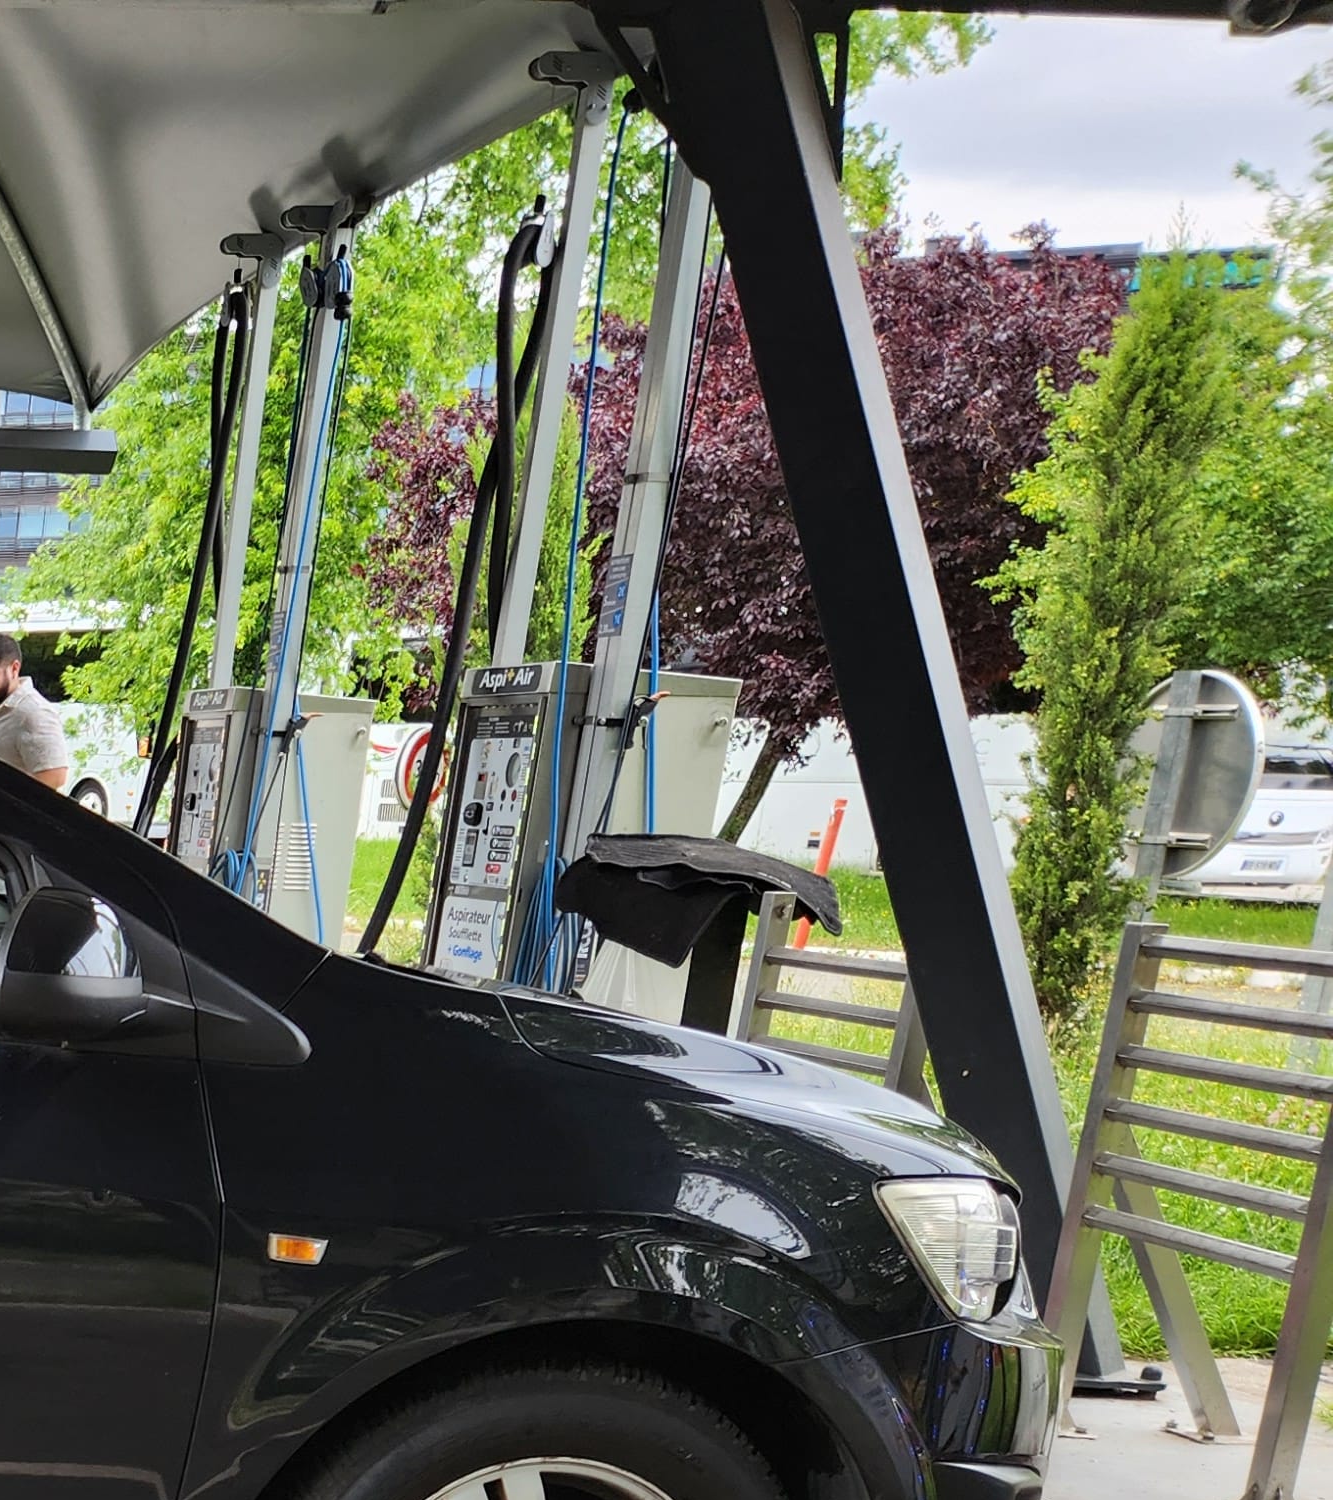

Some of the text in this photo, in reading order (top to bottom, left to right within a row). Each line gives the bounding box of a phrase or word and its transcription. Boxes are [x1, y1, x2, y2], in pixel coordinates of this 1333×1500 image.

[478, 667, 534, 693] Aspi Air
[447, 906, 491, 925] Aspirateur
